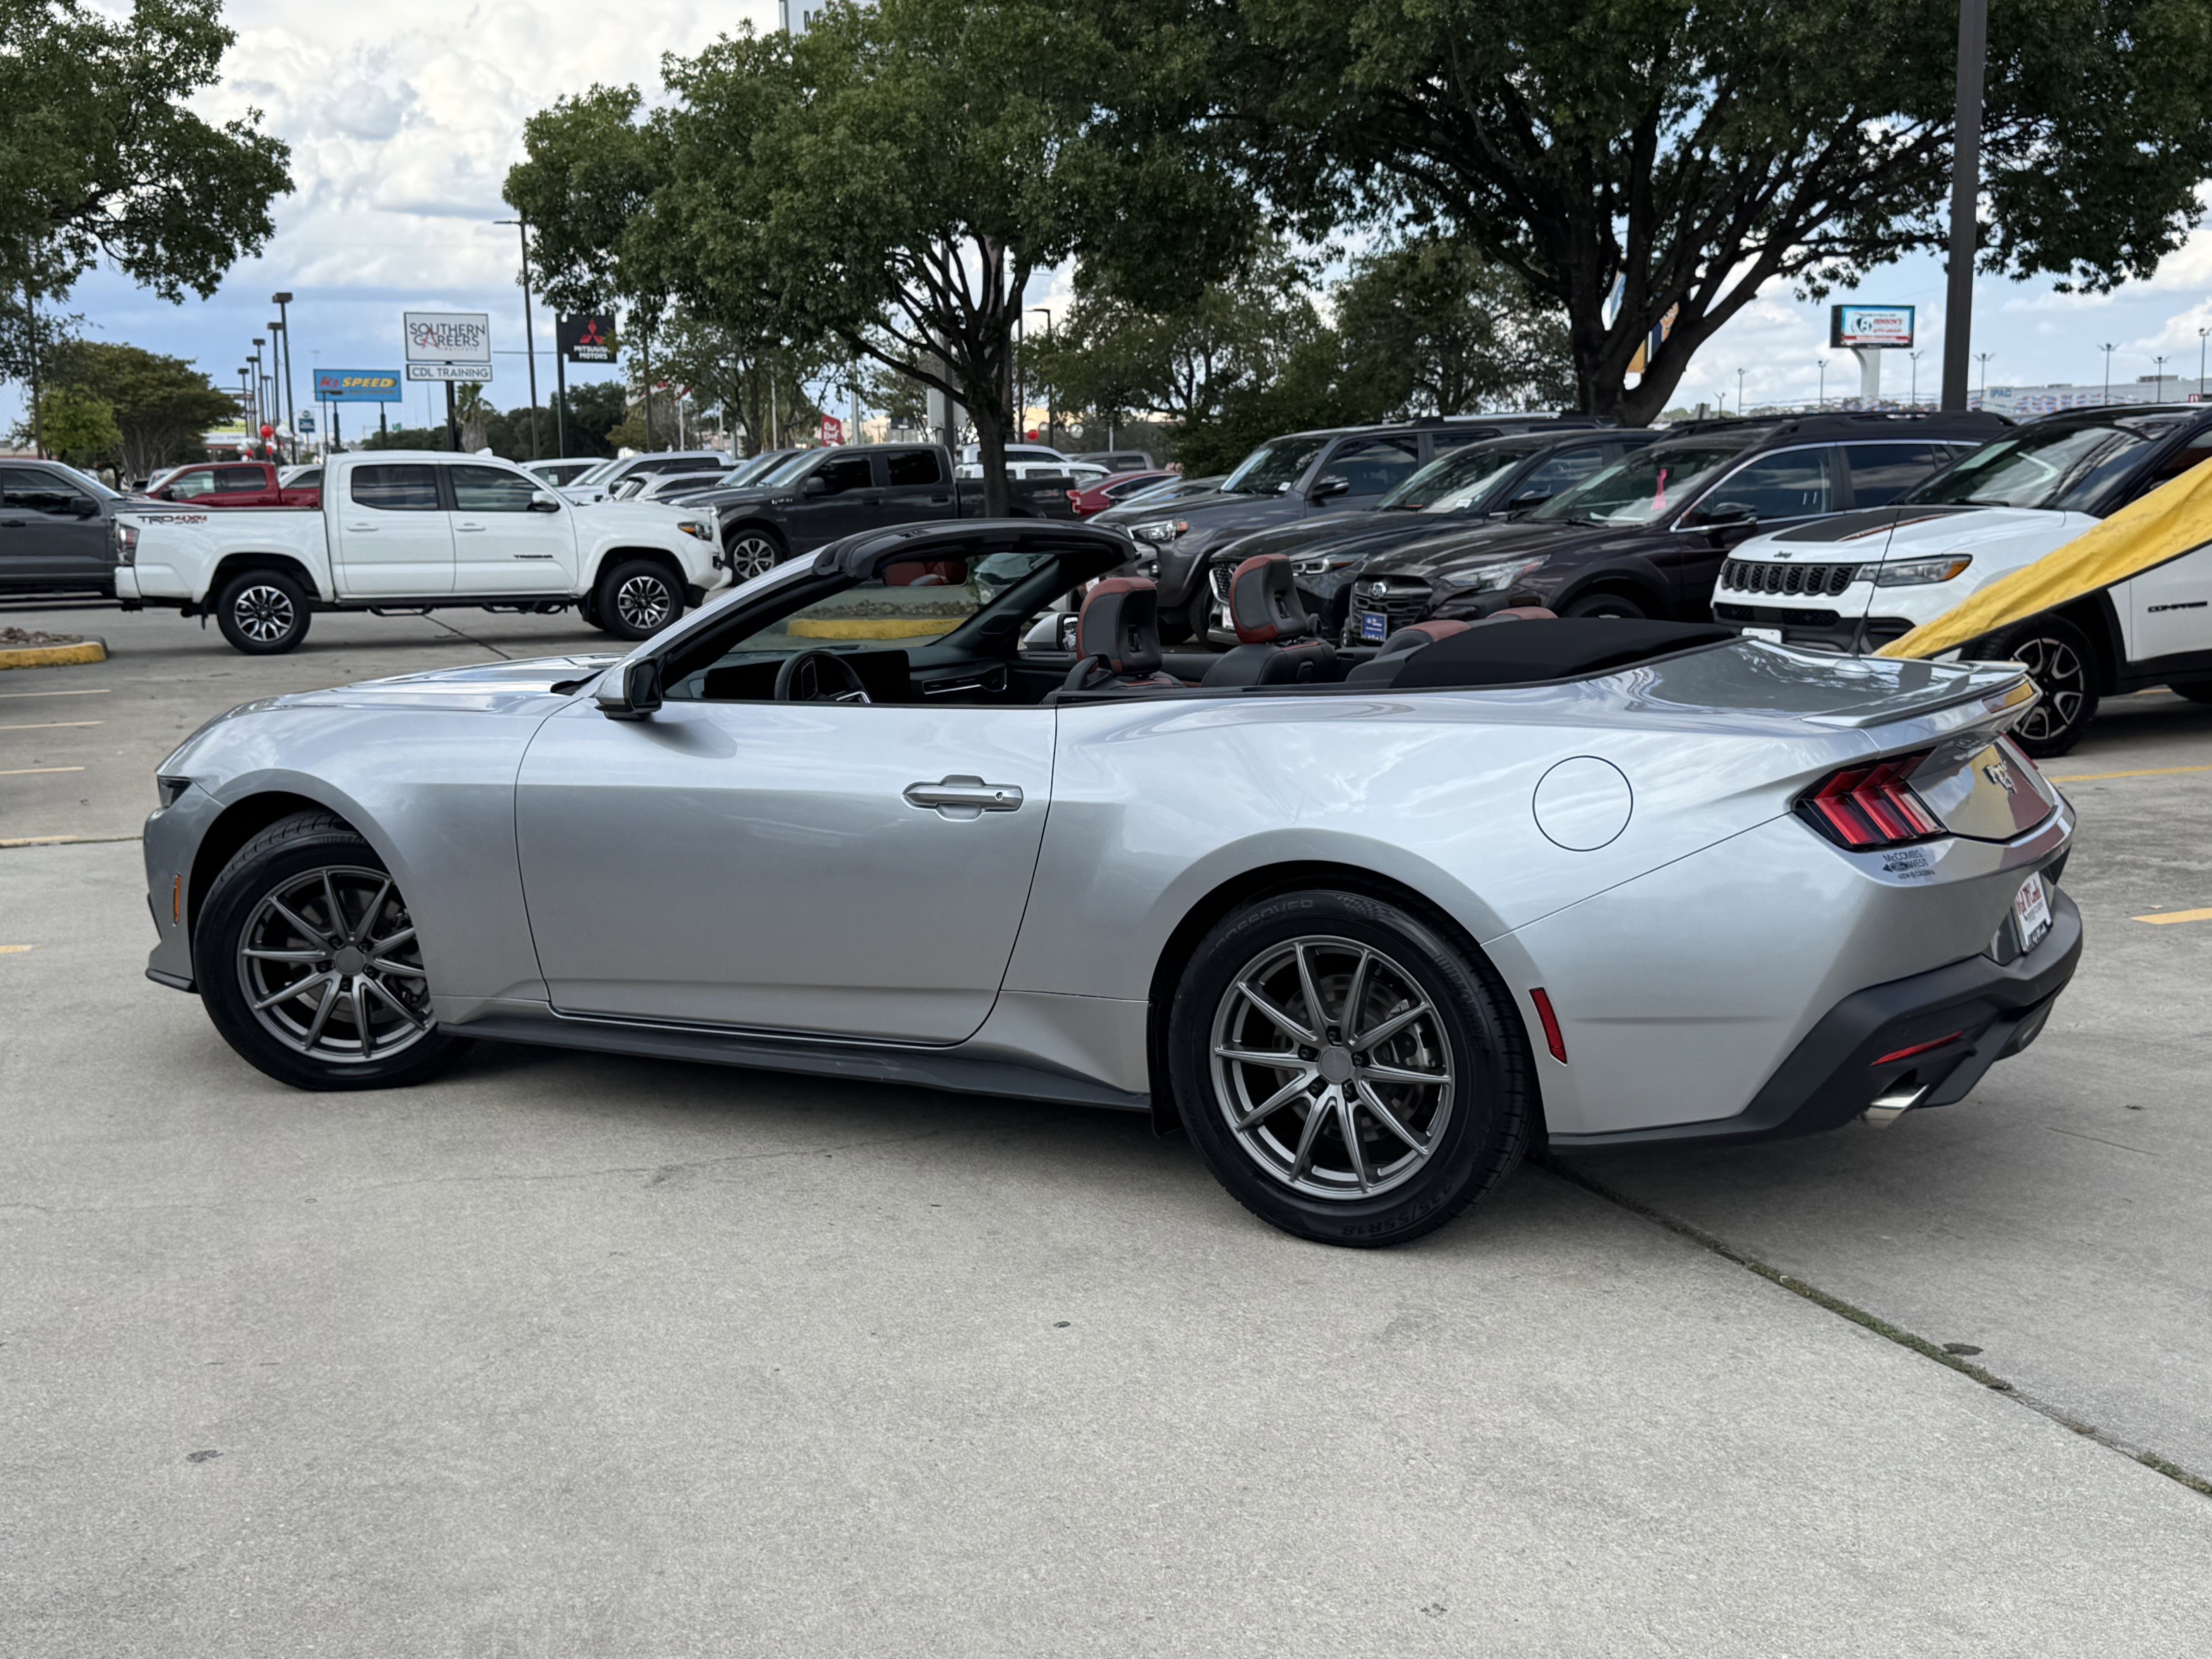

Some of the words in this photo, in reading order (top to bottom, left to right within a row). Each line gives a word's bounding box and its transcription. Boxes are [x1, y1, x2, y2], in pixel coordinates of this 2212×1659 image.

[410, 323, 485, 336] SOUTHERN
[414, 334, 479, 347] CAREERS
[574, 345, 610, 353] MITSUBIS
[412, 368, 434, 377] CDL
[437, 368, 489, 377] TRAINING
[342, 377, 397, 388] SPEED
[137, 515, 174, 524] TRD
[1882, 850, 1923, 862] McCOMBS
